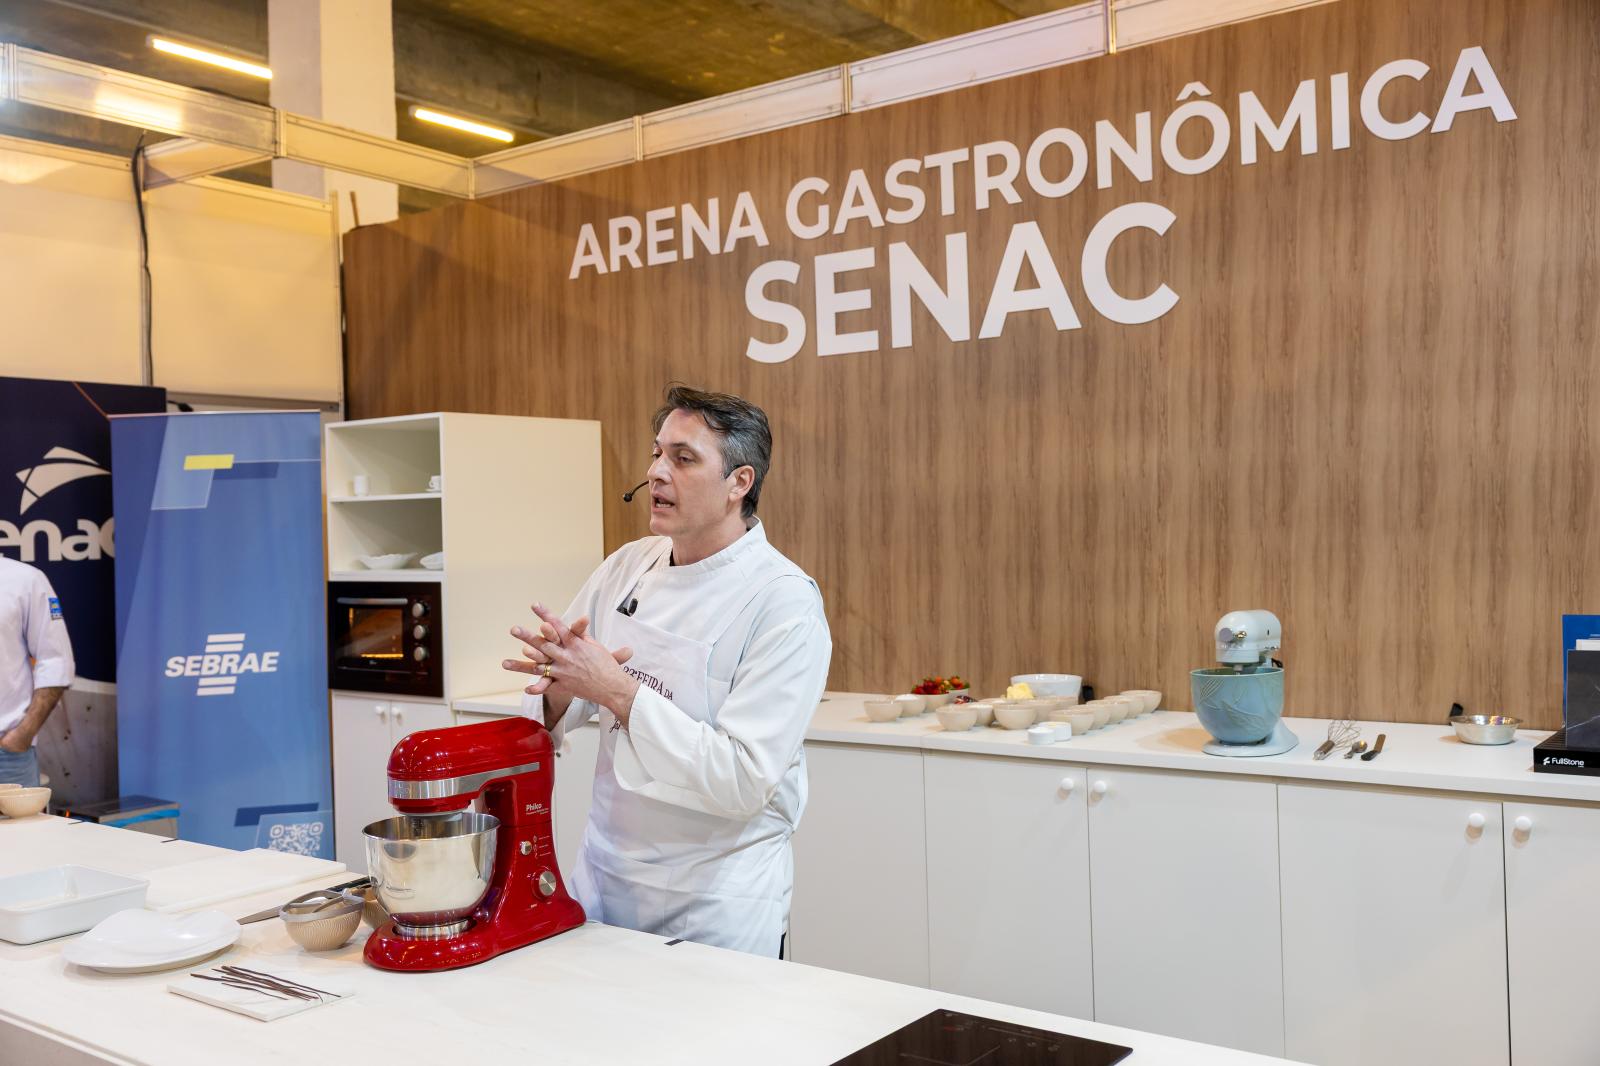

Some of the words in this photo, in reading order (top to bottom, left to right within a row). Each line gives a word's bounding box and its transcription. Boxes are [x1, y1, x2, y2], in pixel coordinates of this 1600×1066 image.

[568, 190, 769, 281] ARENA
[785, 45, 1518, 241] GASTRONÔMICA
[745, 202, 1180, 364] SENAC
[164, 651, 280, 678] SEBRAE
[664, 689, 673, 700] DA
[1552, 757, 1584, 766] FullStone
[525, 803, 542, 812] Philco
